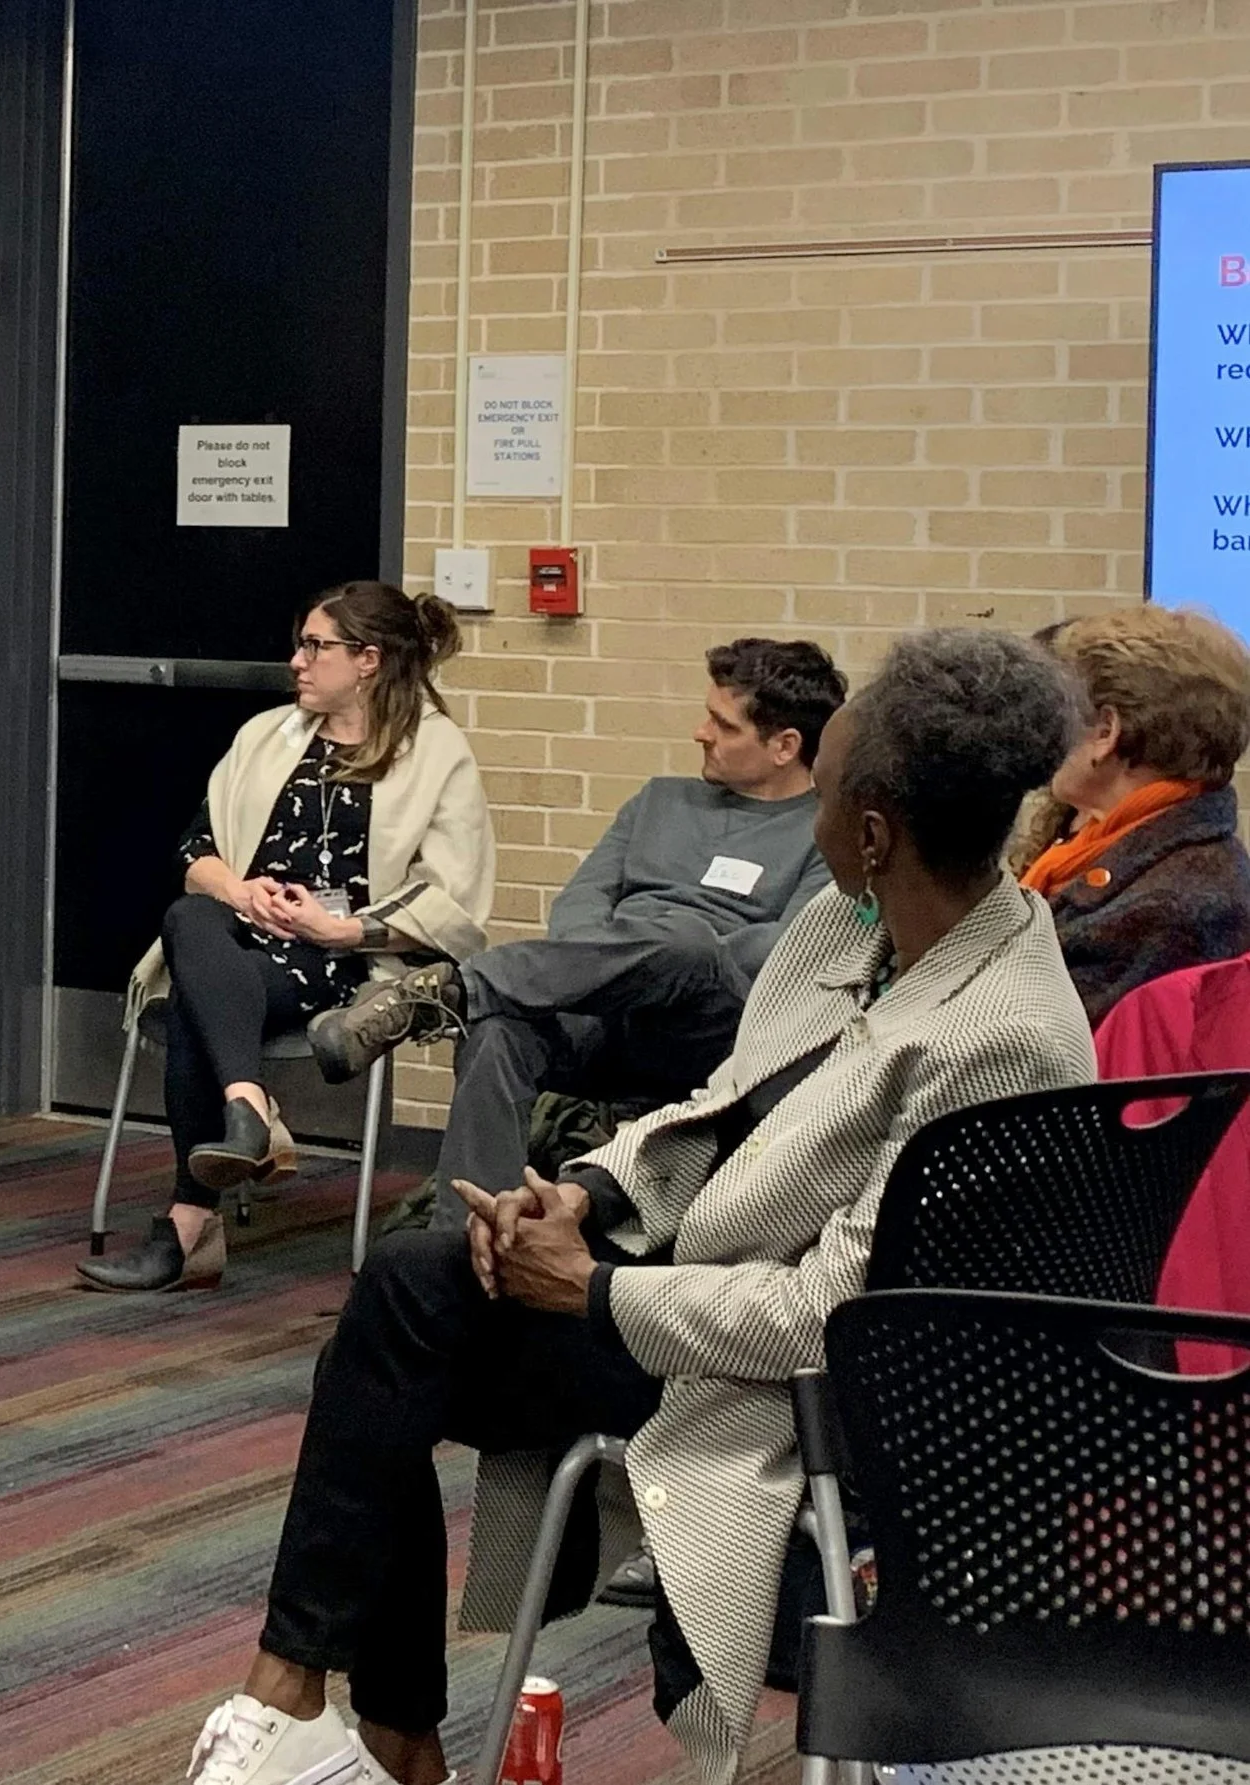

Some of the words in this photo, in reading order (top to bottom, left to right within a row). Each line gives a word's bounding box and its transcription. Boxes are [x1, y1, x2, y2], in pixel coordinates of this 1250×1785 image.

[1220, 255, 1250, 287] B
[1217, 323, 1250, 345] W
[484, 401, 498, 409] DO
[500, 401, 518, 409] NOT
[521, 401, 553, 409] BLOCK
[478, 413, 534, 422] EMERGENCY
[538, 413, 559, 422] EXIT
[511, 426, 525, 435] OR
[197, 440, 232, 450] Please
[235, 440, 249, 450] do
[252, 441, 270, 450] not
[494, 439, 515, 448] FIRE
[517, 440, 541, 448] PULL
[494, 452, 541, 461] STATIONS
[217, 457, 247, 468] block
[192, 476, 251, 488] emergency
[253, 476, 273, 485] exit
[188, 492, 213, 502] door
[216, 492, 238, 502] with
[241, 492, 276, 502] tables.
[1213, 529, 1250, 551] ba
